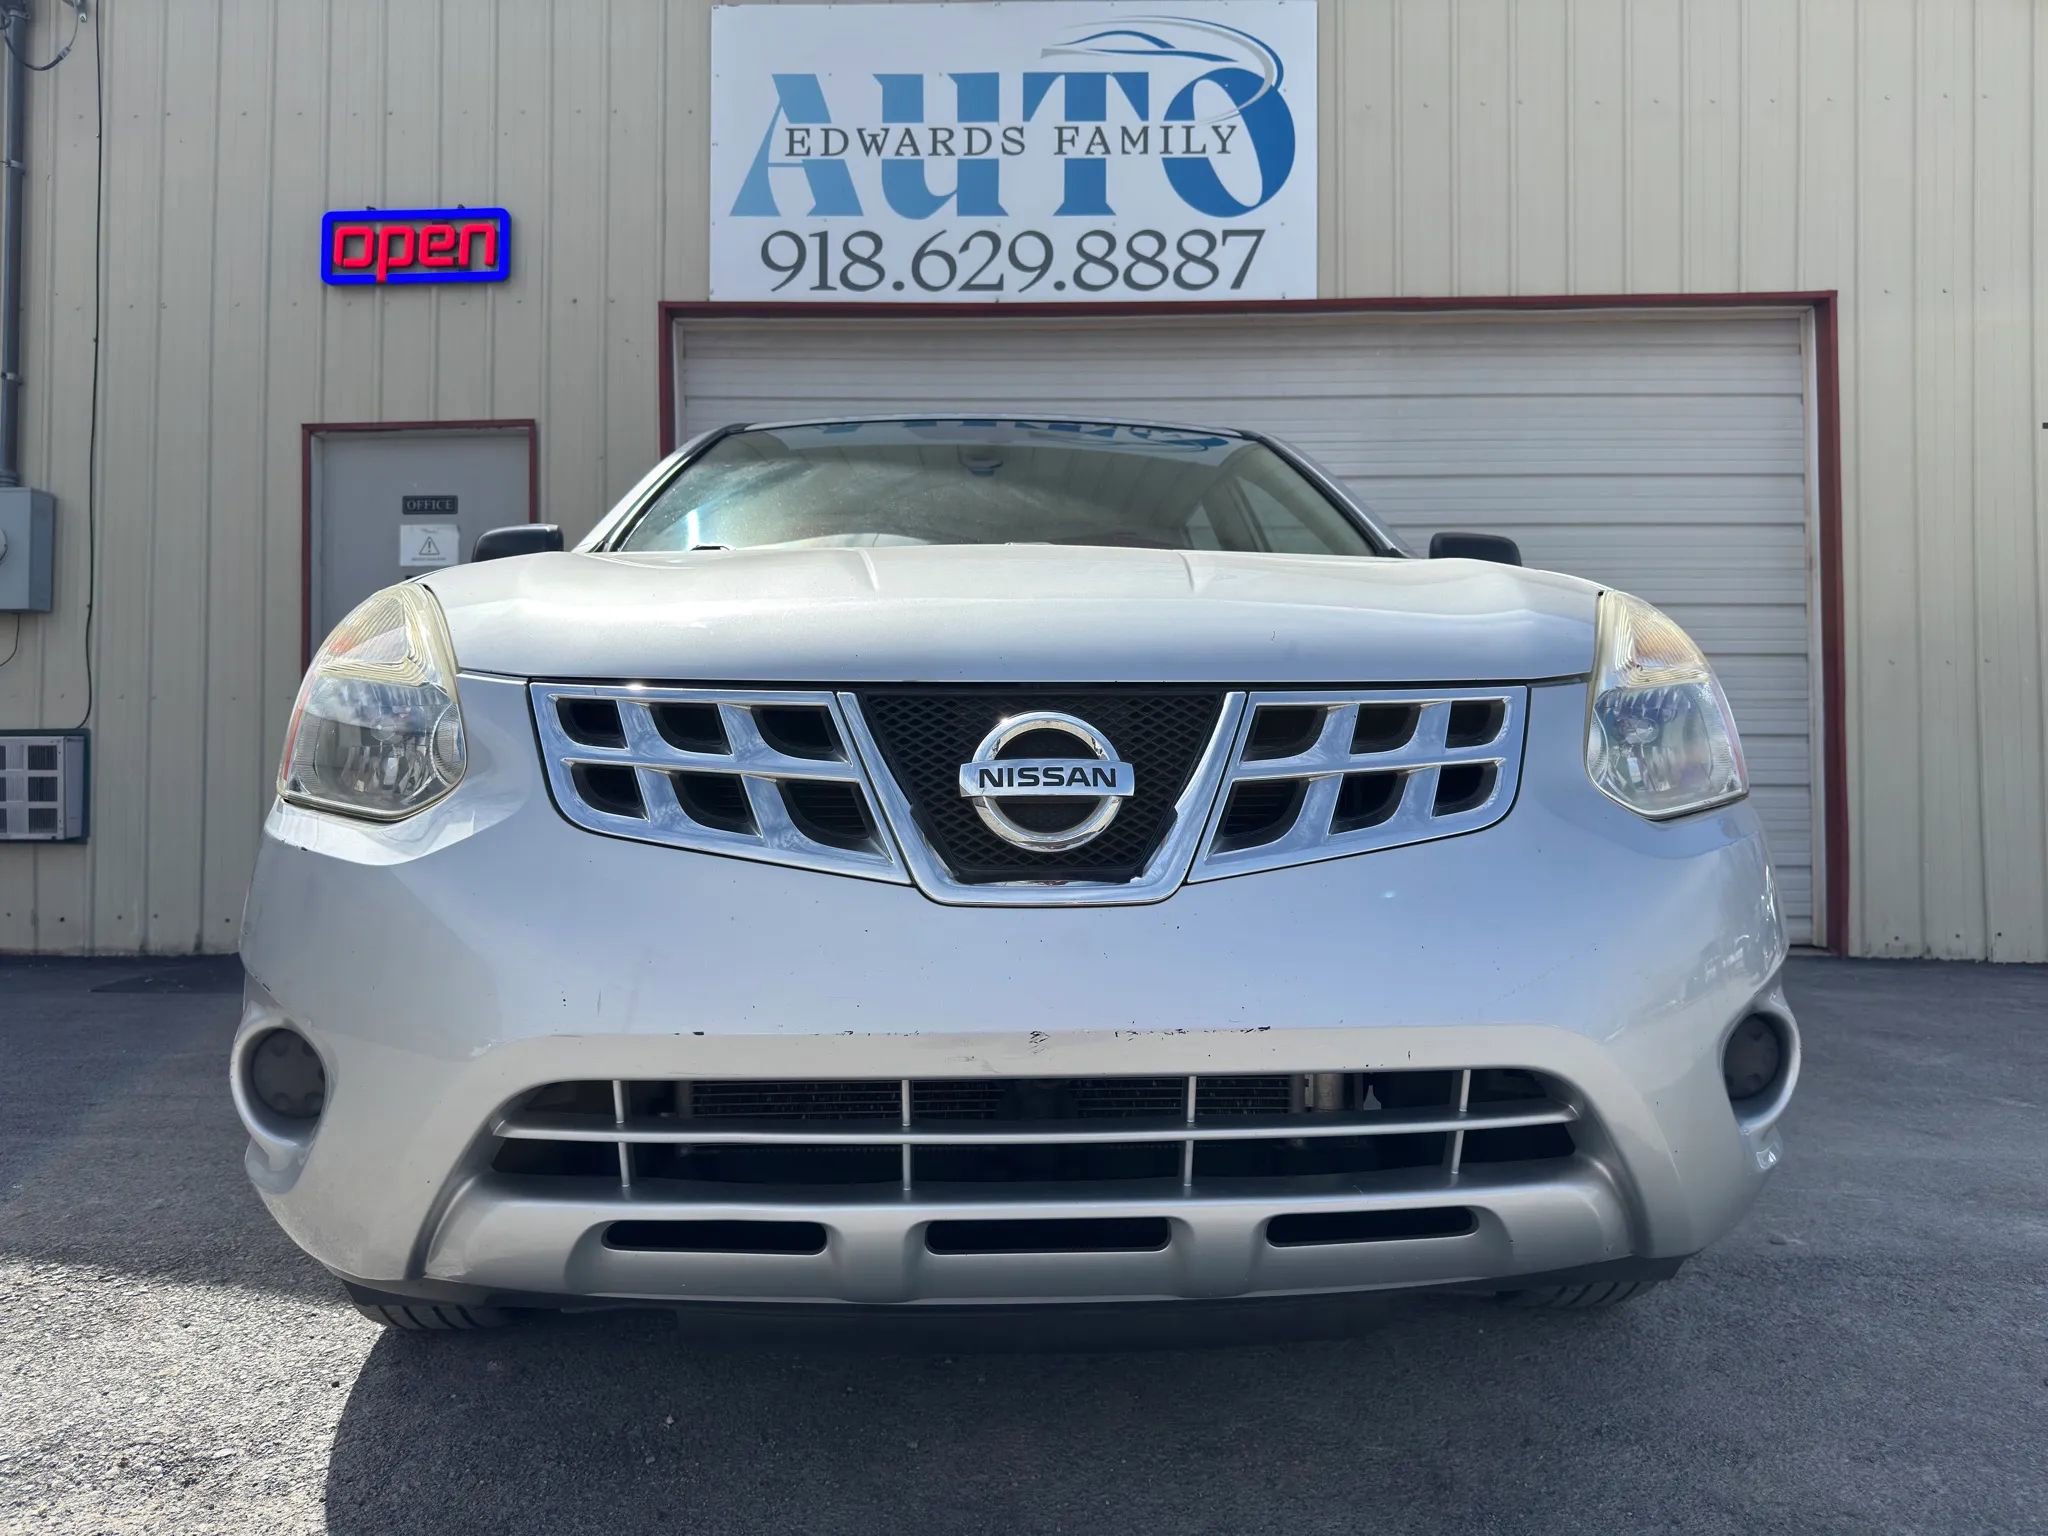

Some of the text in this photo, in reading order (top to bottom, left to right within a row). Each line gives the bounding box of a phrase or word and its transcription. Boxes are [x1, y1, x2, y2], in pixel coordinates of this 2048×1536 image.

[729, 67, 1296, 220] AUTO
[785, 124, 1238, 157] EDWARDS FAMILY
[333, 223, 496, 283] open
[760, 228, 1266, 294] 918.629.8887
[406, 500, 453, 510] OFFICE
[979, 767, 1117, 788] NISSAN
